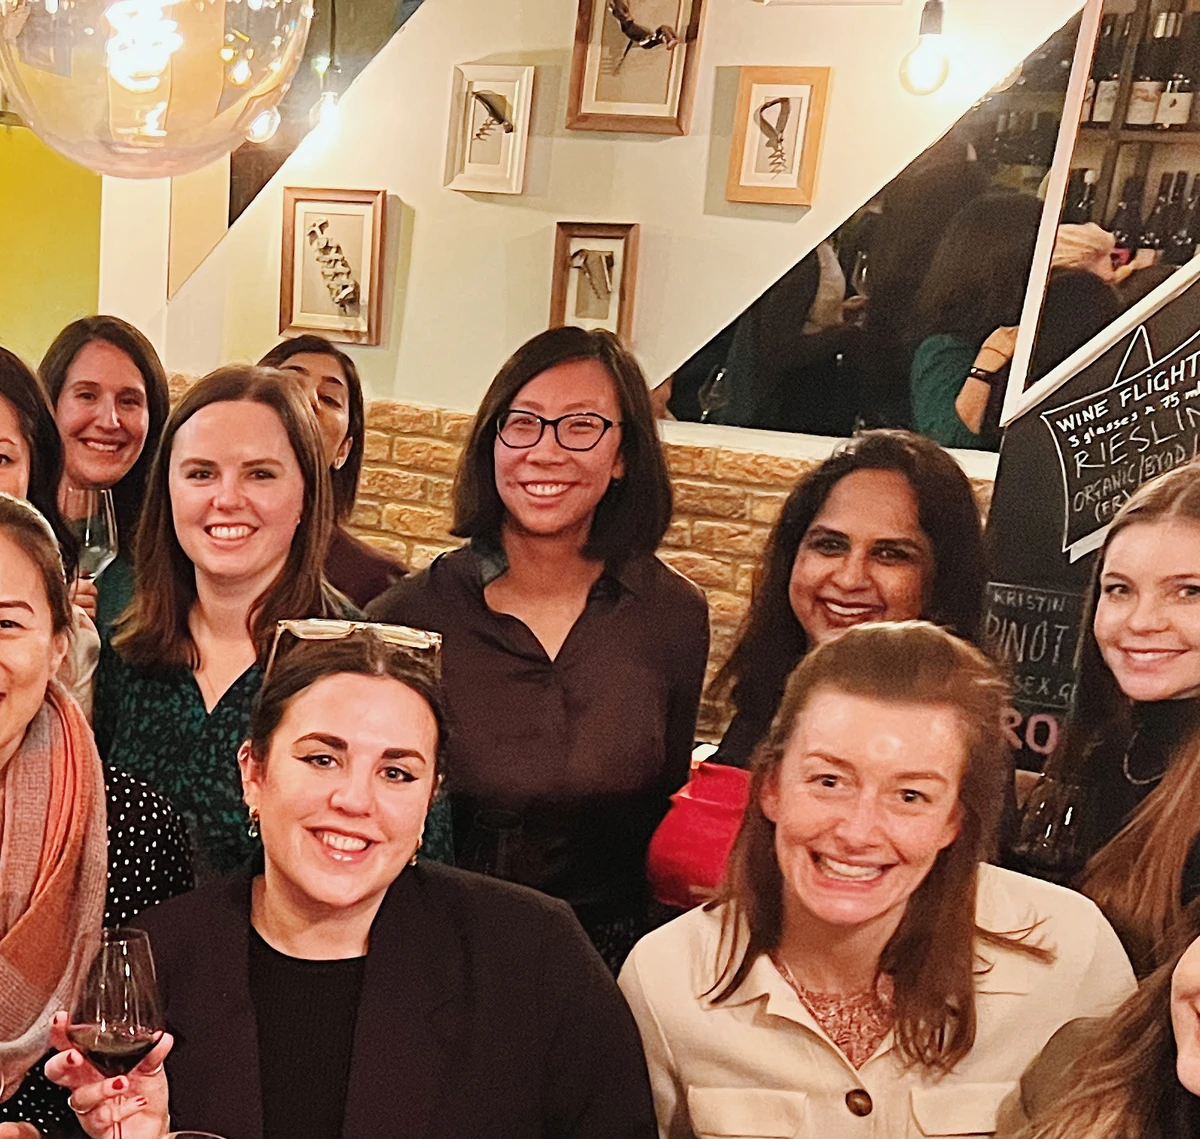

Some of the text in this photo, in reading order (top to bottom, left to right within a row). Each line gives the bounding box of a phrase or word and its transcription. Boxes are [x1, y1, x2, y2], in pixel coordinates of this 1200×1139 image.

[1056, 399, 1108, 432] WINE
[1083, 411, 1139, 445] glasses
[1160, 391, 1180, 409] 75
[985, 608, 1070, 667] PINOT
[1000, 706, 1060, 755] RO
